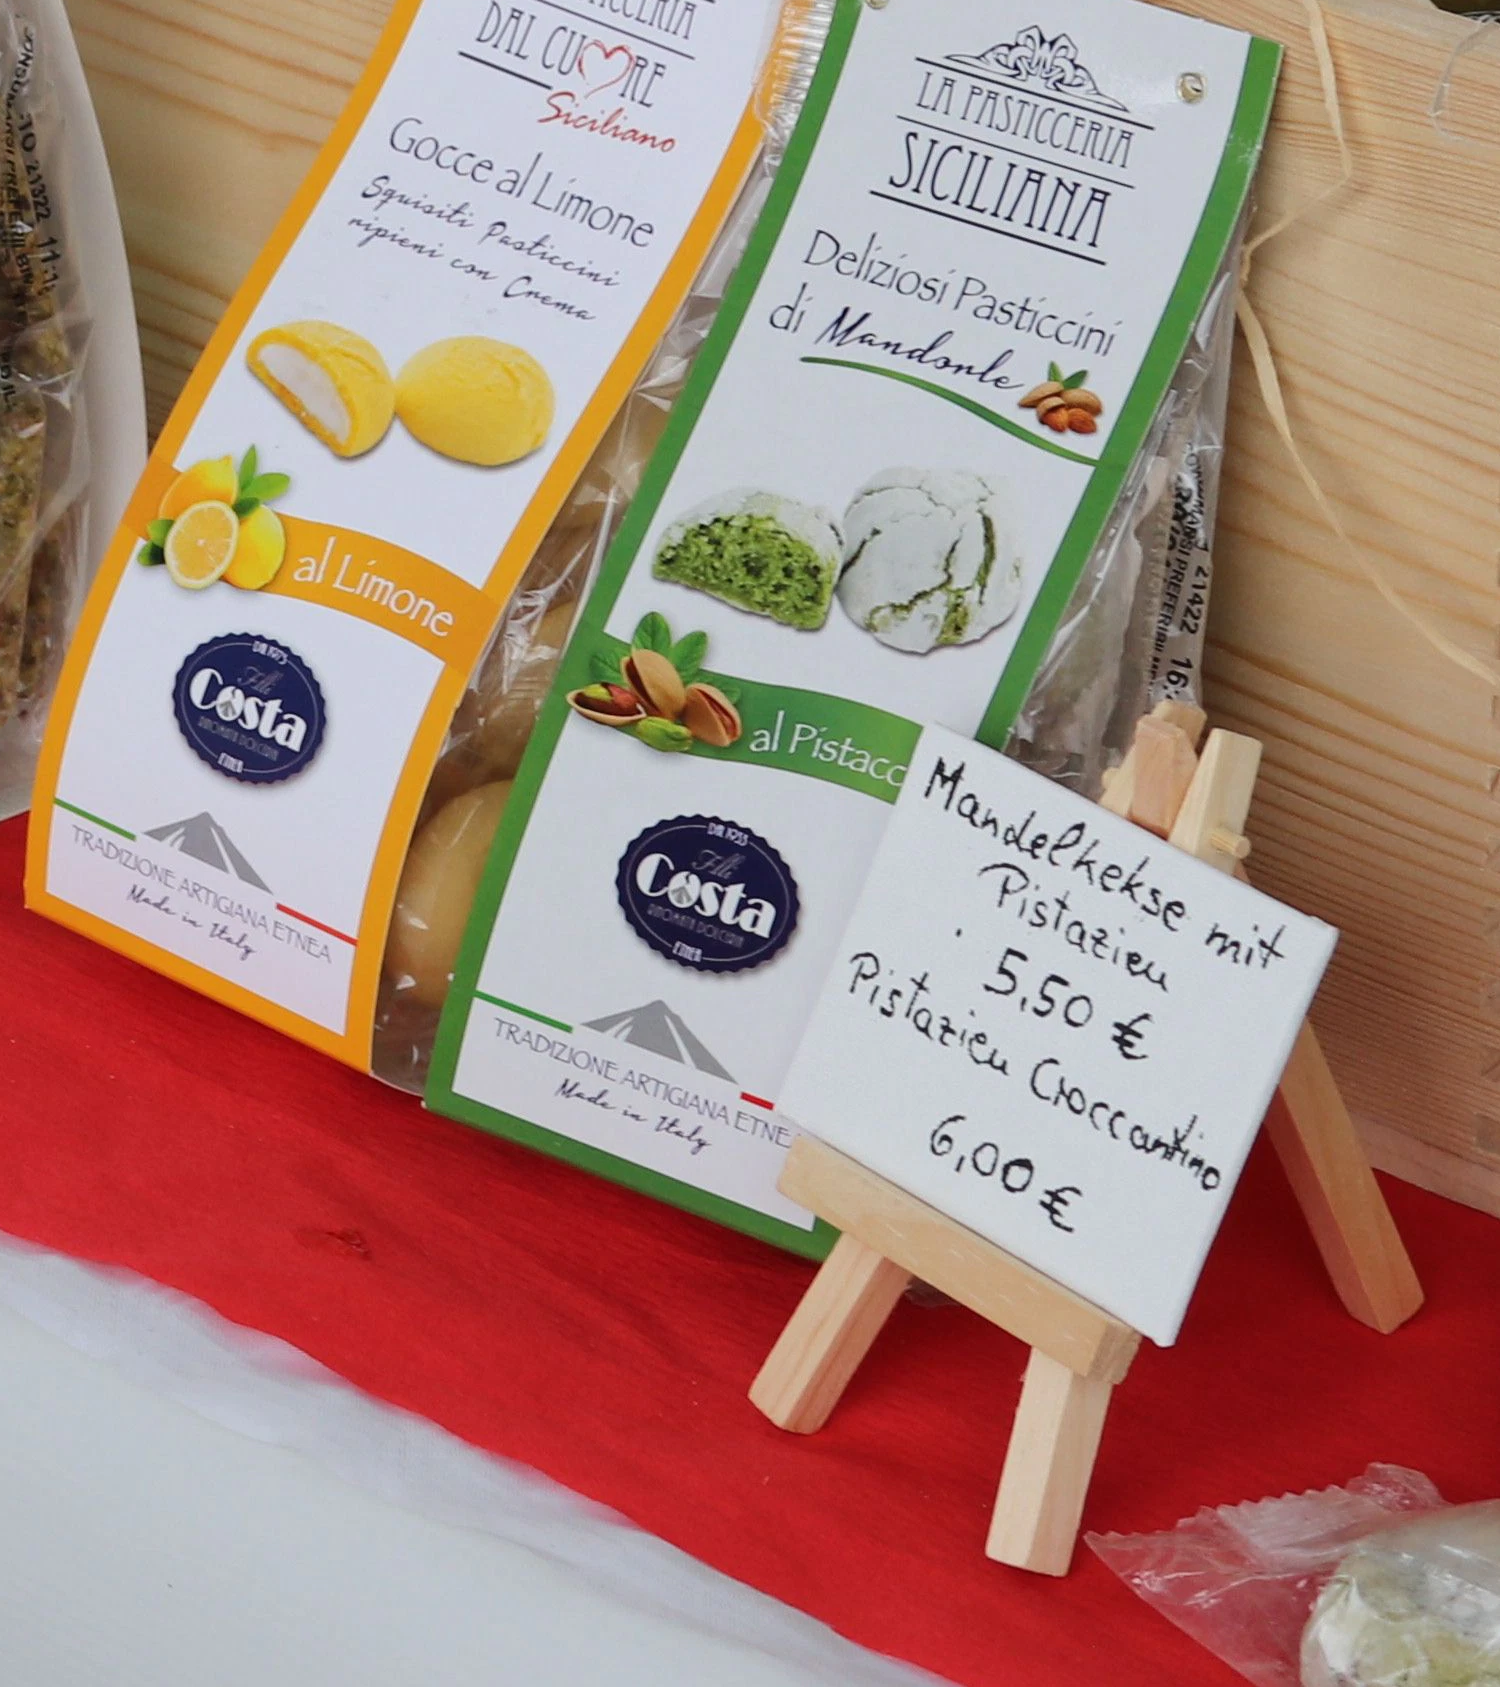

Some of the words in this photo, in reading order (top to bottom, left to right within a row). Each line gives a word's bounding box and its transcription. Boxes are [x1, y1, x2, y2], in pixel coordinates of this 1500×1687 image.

[475, 0, 532, 62] DAL
[536, 91, 678, 154] Siciliano
[914, 69, 958, 116] LA
[960, 84, 1136, 169] PASTICCERIA
[360, 173, 477, 231] Squisiti
[484, 220, 622, 289] Pasticcini
[387, 116, 494, 186] Gocce
[496, 151, 545, 198] al
[532, 168, 656, 249] Limone
[888, 130, 1113, 251] SICILIANA
[347, 213, 444, 262] ripieni
[449, 255, 497, 285] con
[501, 275, 599, 323] Crema
[801, 227, 956, 307] Deliziosi
[953, 274, 1123, 360] Pasticcini
[767, 282, 806, 336] di
[813, 305, 1027, 393] Mandorle
[291, 537, 333, 586] al
[331, 555, 458, 638] Limone
[188, 666, 308, 754] Costa
[748, 710, 782, 754] al
[71, 822, 176, 888] TRADIZIONE
[177, 874, 271, 933] ARTIGIANA
[271, 918, 333, 965] ETNEA
[635, 852, 777, 940] Costa
[923, 755, 1188, 933] Mandelkekse
[1204, 924, 1287, 970] mit
[125, 881, 179, 923] Made
[180, 908, 203, 932] in
[207, 920, 257, 964] Italy
[982, 945, 1095, 1030] 5,50
[493, 1016, 619, 1083] TRADIZIONE
[618, 1064, 732, 1128] ARTIGIANA
[554, 1077, 617, 1116] Made
[621, 1102, 650, 1125] in
[652, 1109, 712, 1156] Italy
